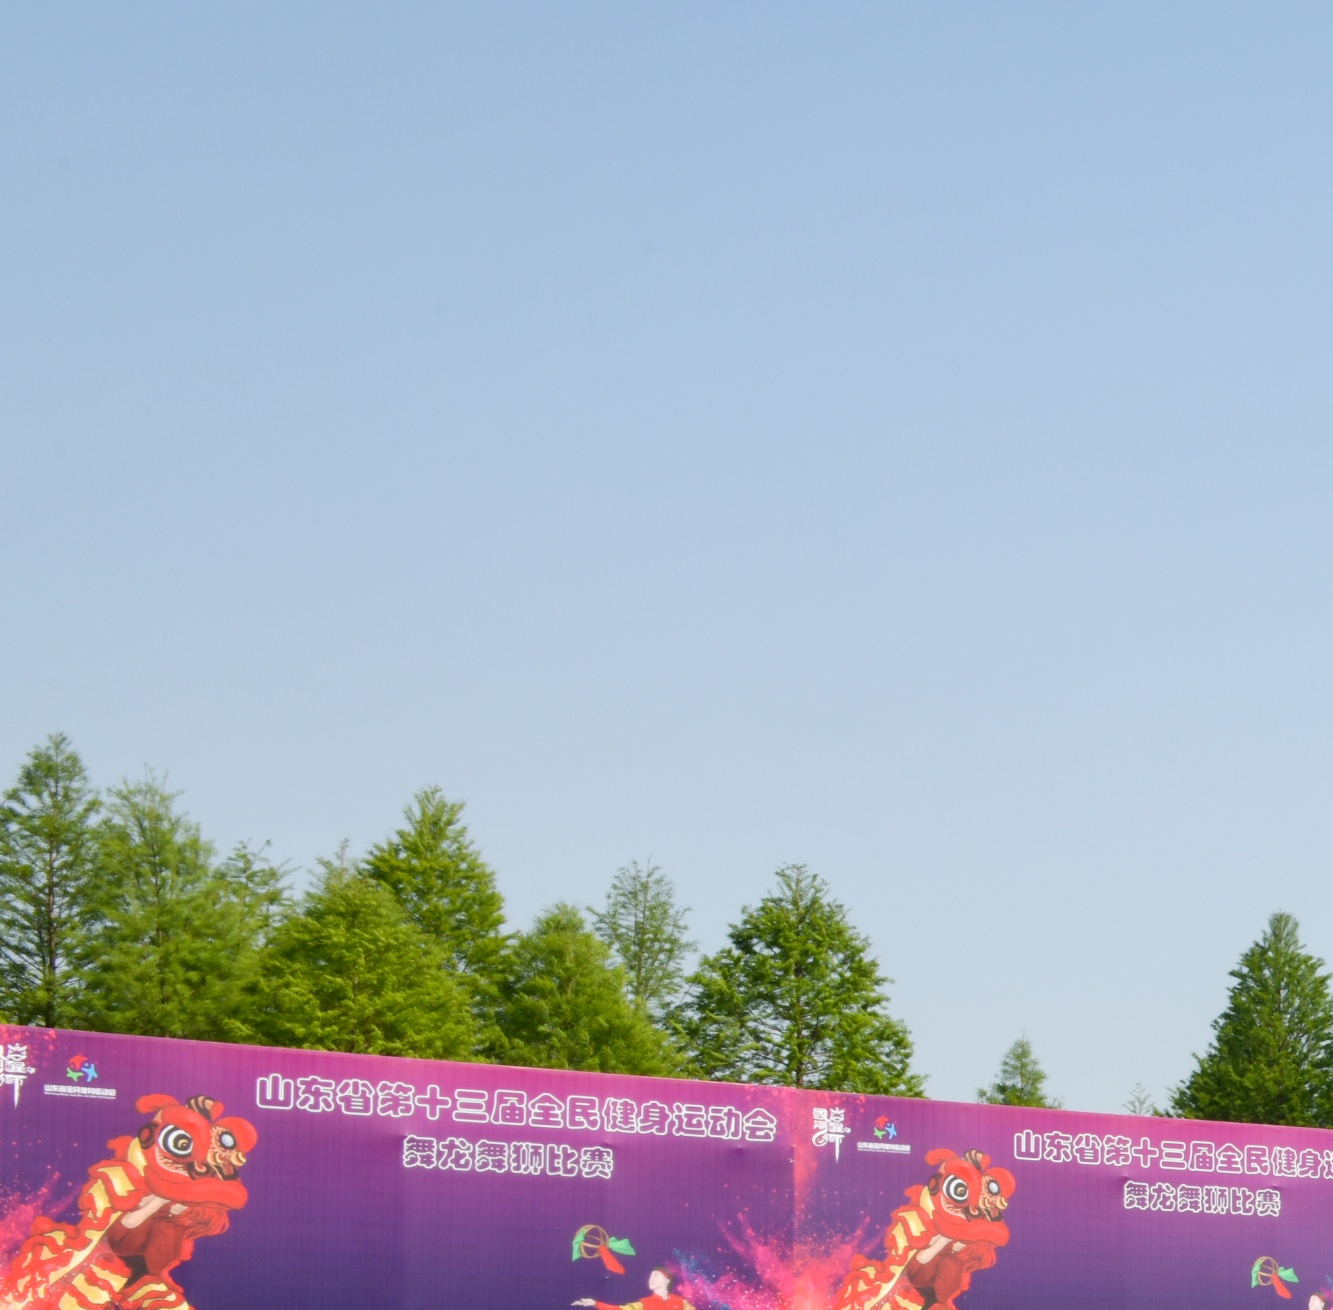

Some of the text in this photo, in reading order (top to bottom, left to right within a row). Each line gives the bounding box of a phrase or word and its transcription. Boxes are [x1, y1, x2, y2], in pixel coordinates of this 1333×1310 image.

[256, 1073, 778, 1142] 山东省第十三届全民健身运动会
[403, 1134, 614, 1179] 舞龙舞狮比赛
[1123, 1180, 1281, 1217] 舞龙舞狮比赛
